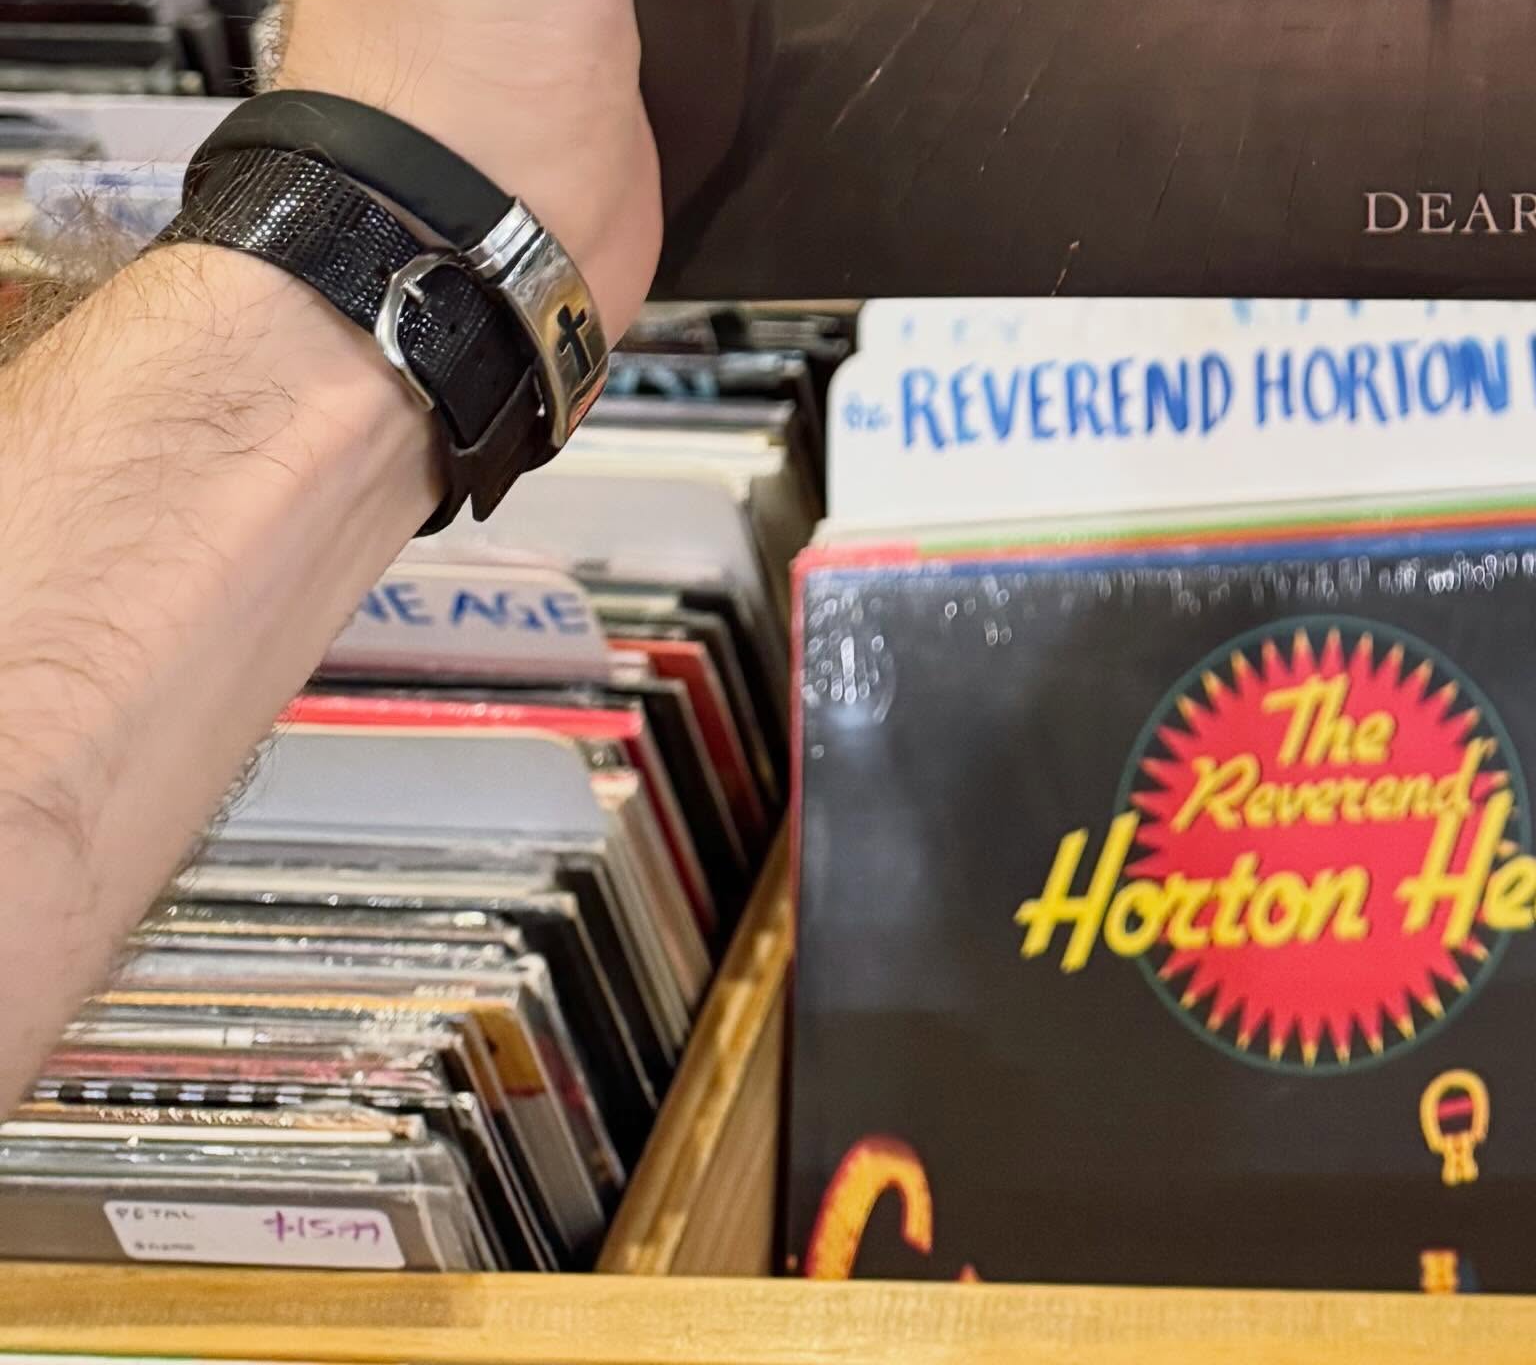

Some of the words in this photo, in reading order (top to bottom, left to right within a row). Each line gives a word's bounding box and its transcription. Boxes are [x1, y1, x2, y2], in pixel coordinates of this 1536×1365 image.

[899, 348, 1234, 452] REVEREND
[1253, 335, 1510, 427] HORTON
[1262, 672, 1396, 767] The
[1169, 737, 1490, 833] Reverend
[1013, 810, 1369, 974] Horton
